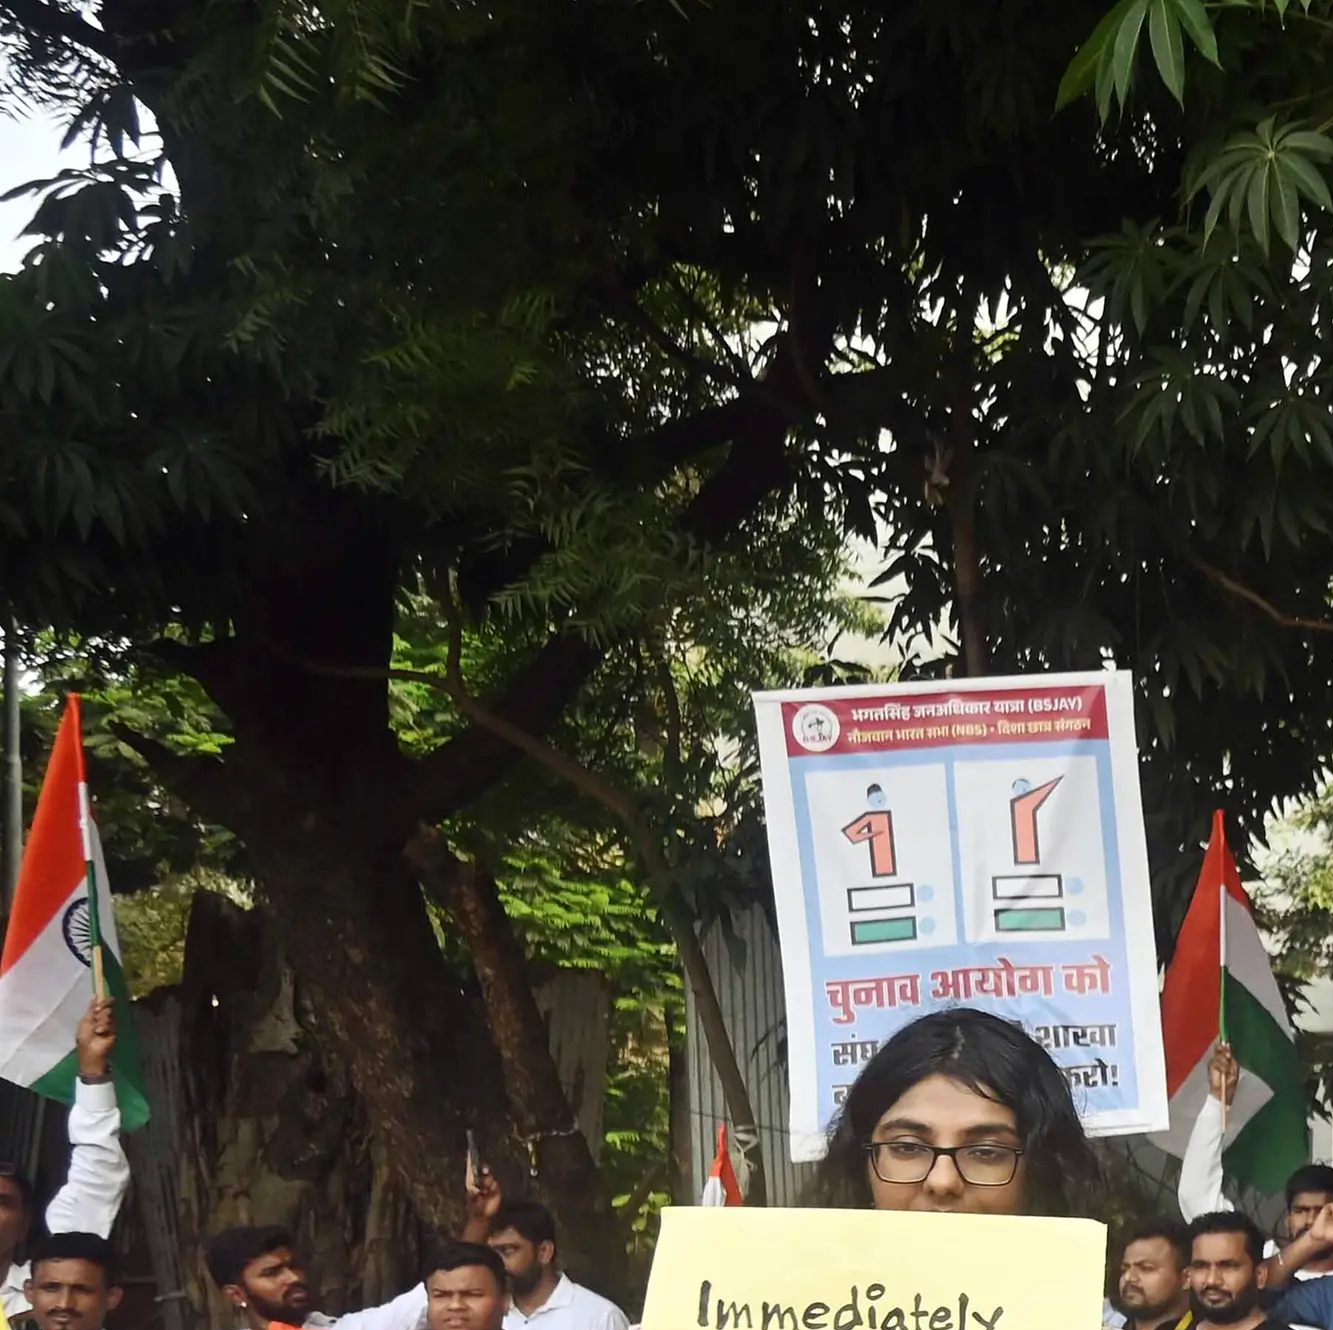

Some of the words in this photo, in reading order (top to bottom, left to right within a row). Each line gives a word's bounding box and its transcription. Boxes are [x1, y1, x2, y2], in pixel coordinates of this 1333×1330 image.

[826, 974, 920, 1024] चुनाव
[931, 957, 1053, 999] आयोग
[1062, 955, 1110, 995] को
